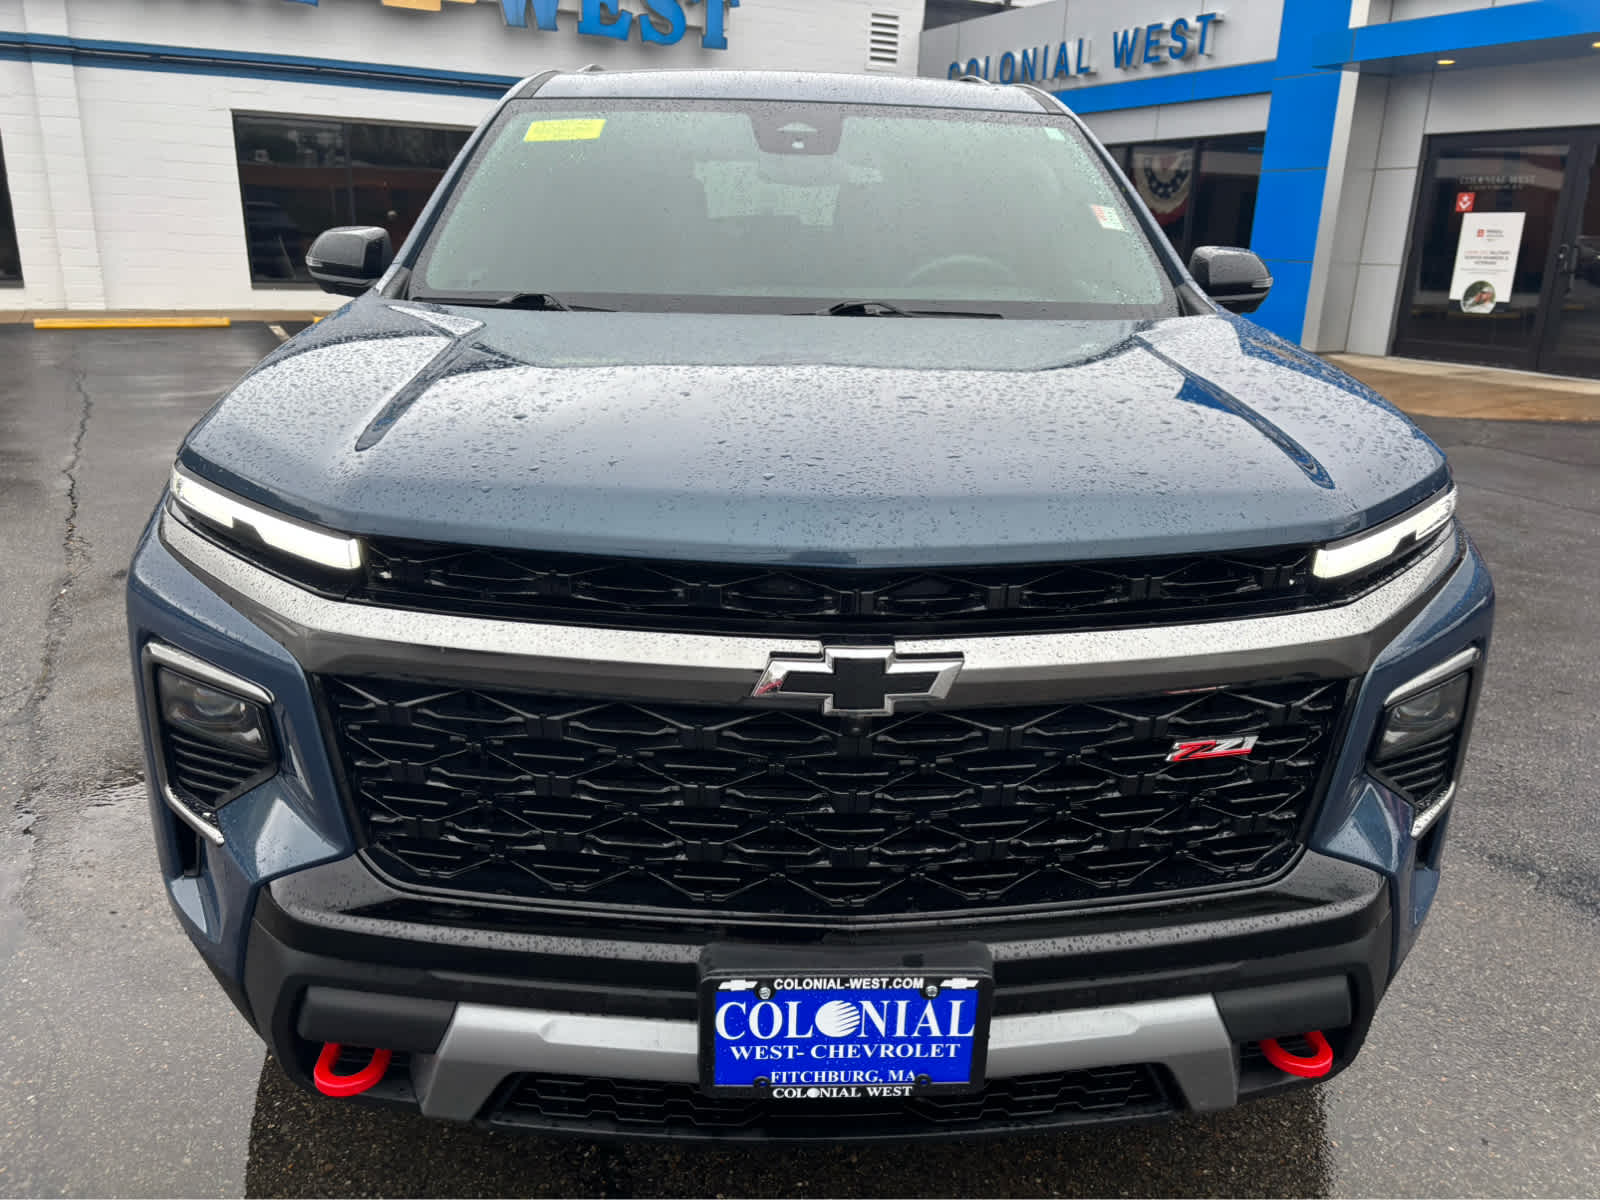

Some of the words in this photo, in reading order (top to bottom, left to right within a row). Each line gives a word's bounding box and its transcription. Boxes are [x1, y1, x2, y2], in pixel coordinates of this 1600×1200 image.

[948, 38, 1091, 85] COLONIAL
[1112, 12, 1218, 69] WEST
[1166, 735, 1259, 762] Z71
[773, 977, 925, 991] COLONIAL-WEST.COM
[715, 999, 976, 1041] COLONIAL
[730, 1045, 805, 1060] WEST-
[810, 1043, 961, 1060] CHEVROLET
[770, 1069, 884, 1084] FITCHBURG,
[888, 1069, 916, 1083] MA
[866, 1085, 914, 1098] WEST
